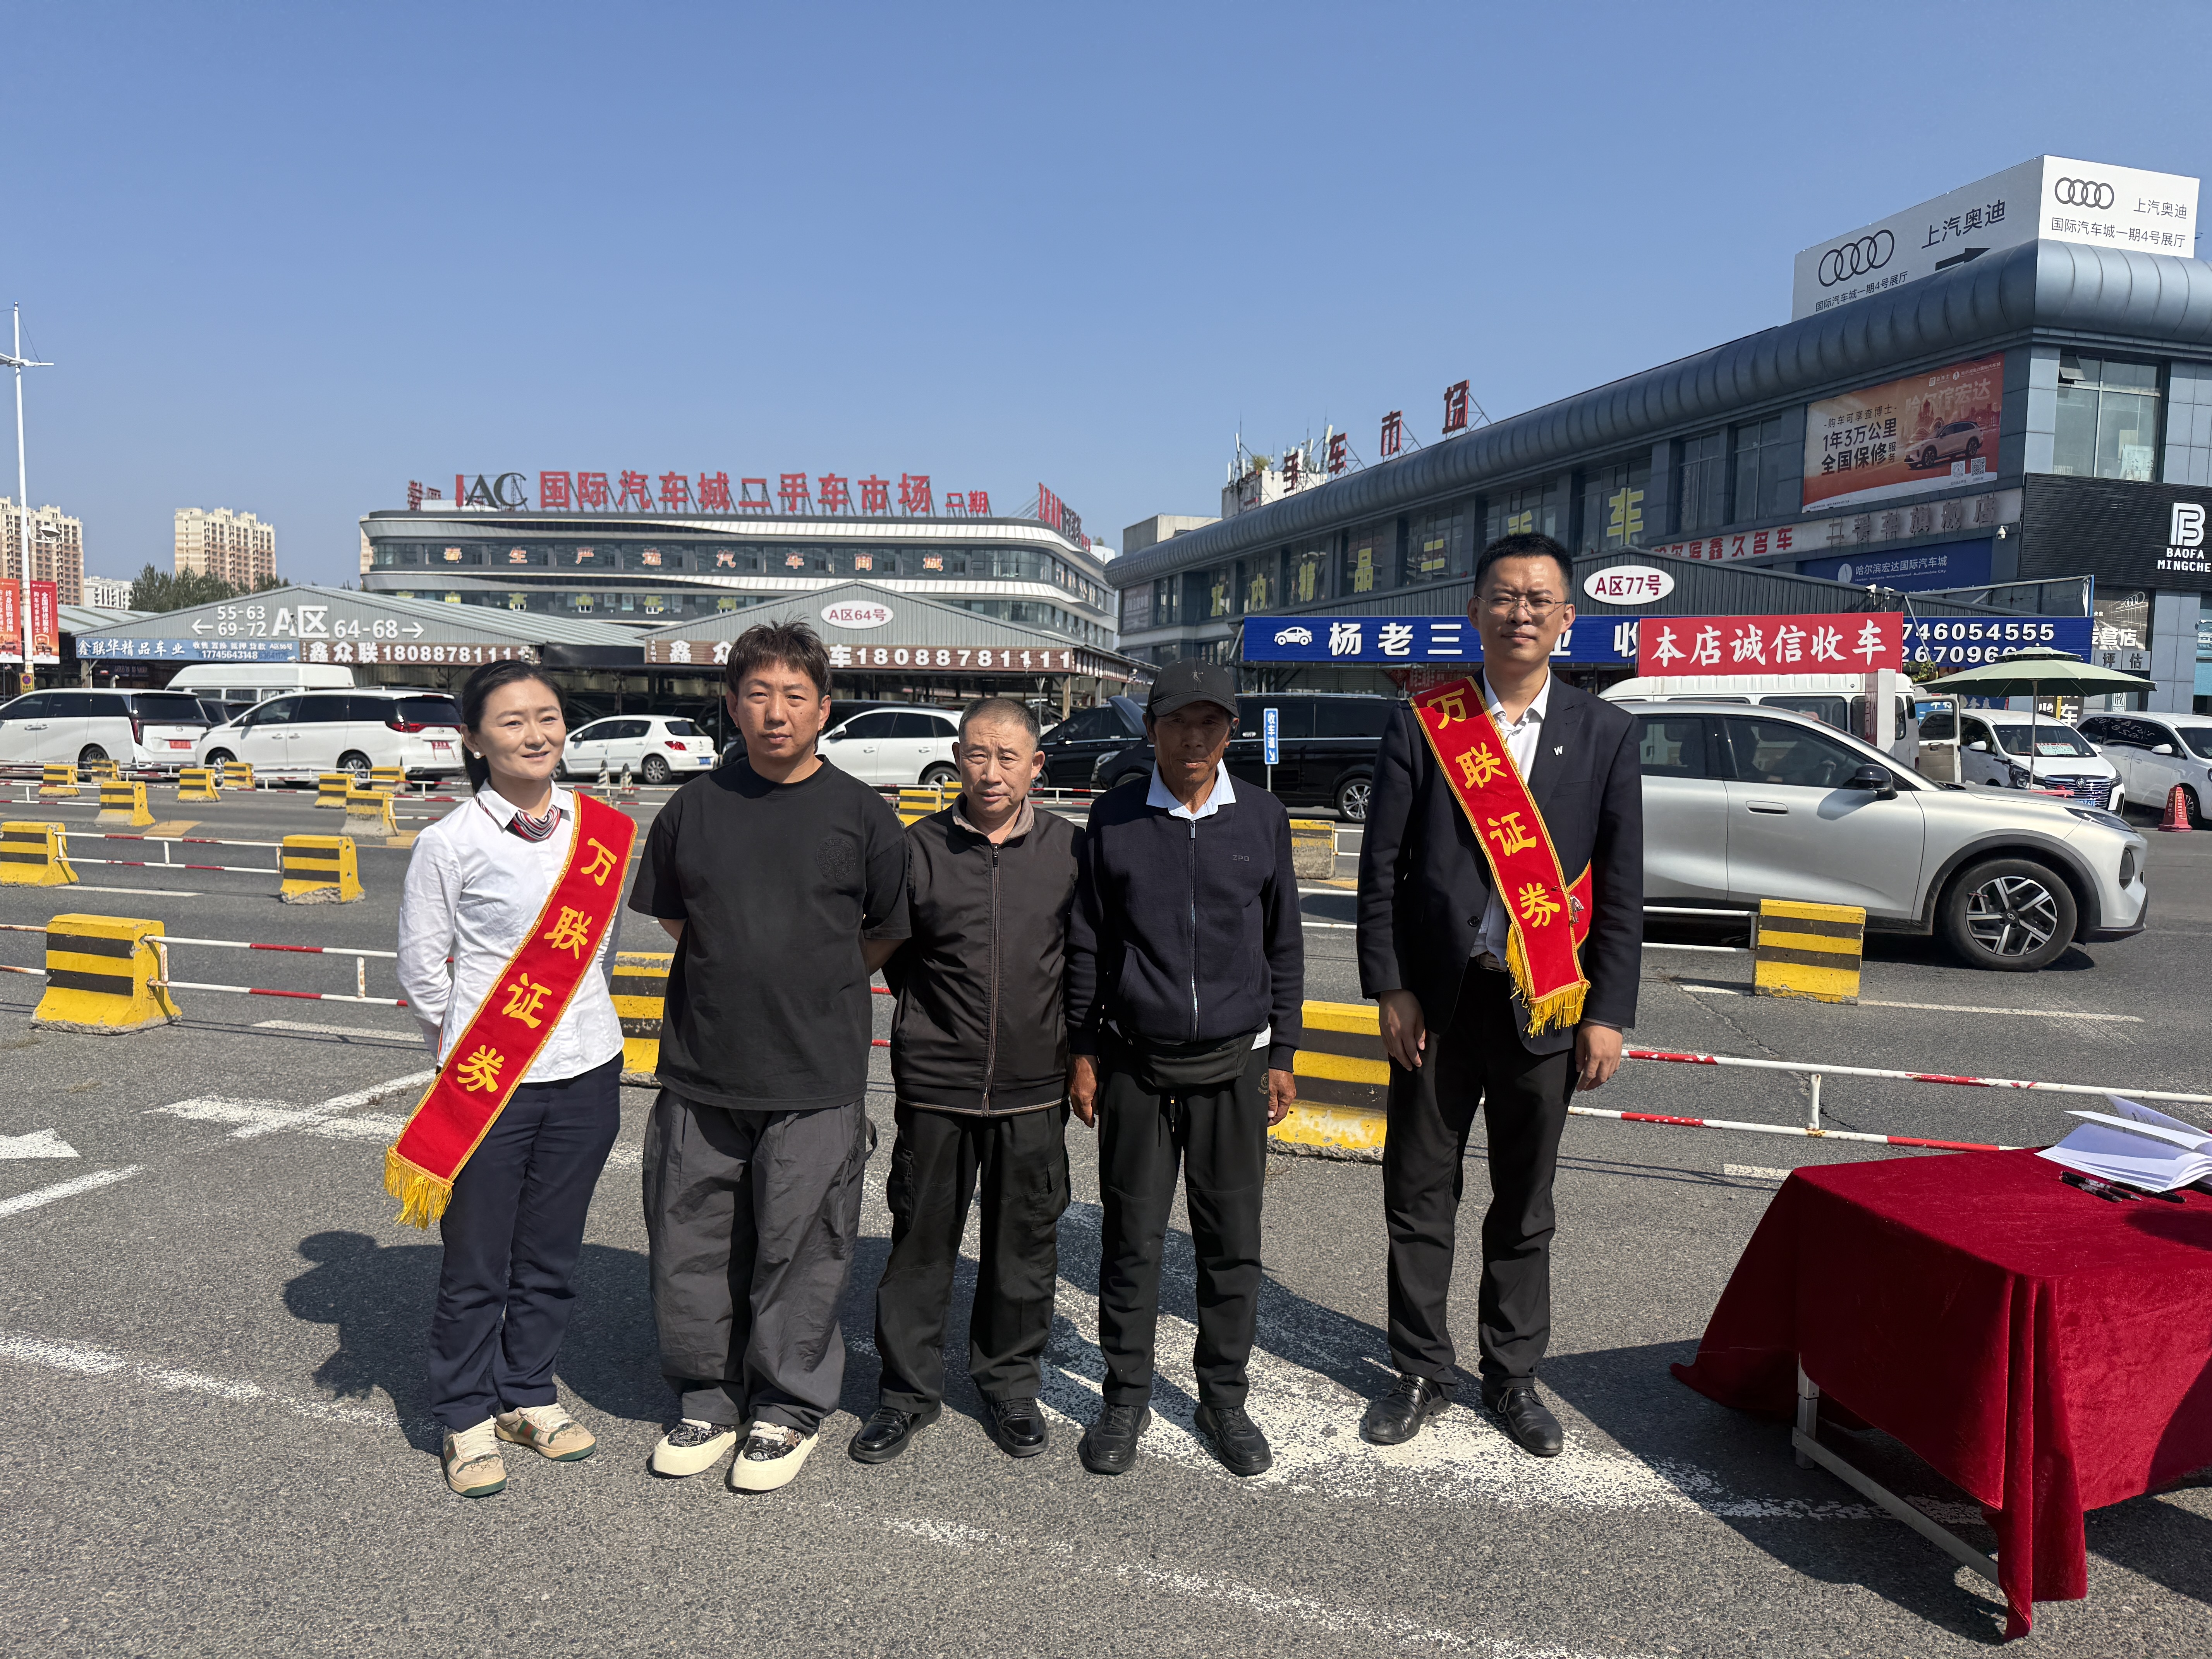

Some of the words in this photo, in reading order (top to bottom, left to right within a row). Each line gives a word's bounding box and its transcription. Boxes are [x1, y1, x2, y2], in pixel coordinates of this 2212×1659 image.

[2133, 198, 2187, 219] 上汽奥迪
[1921, 199, 2005, 249] 上汽奥迪
[2051, 217, 2186, 247] 国际汽车城一期4号展厅
[1815, 271, 1908, 312] 国际汽车城一期4号展厅
[1823, 417, 1896, 452] 1年3万公里
[539, 469, 931, 513] 国际汽车城二手车市场
[945, 490, 988, 514] 二期
[2166, 548, 2205, 559] BAOFA
[1855, 555, 1948, 575] 哈尔滨宏达国际汽车城
[2157, 560, 2212, 572] MINGCHE
[1594, 575, 1662, 596] A区77号
[218, 605, 266, 620] 55-63
[271, 605, 330, 639] A区
[334, 619, 399, 639] 64-68
[829, 608, 886, 622] A区64号
[218, 621, 267, 638] 69-72
[1328, 622, 1571, 657] 杨老三业
[78, 638, 185, 657] 鑫联华精品车业
[309, 641, 378, 663] 鑫众联
[1651, 619, 1887, 668] 本店诚信收车
[202, 650, 258, 659] 17745643148
[857, 648, 1070, 669] 18088781111
[2102, 652, 2143, 669] 评估
[1267, 712, 1276, 749] 收车道
[1553, 745, 1563, 756] W
[1427, 687, 1561, 928] 万联证券
[457, 837, 617, 1092] 万联证券
